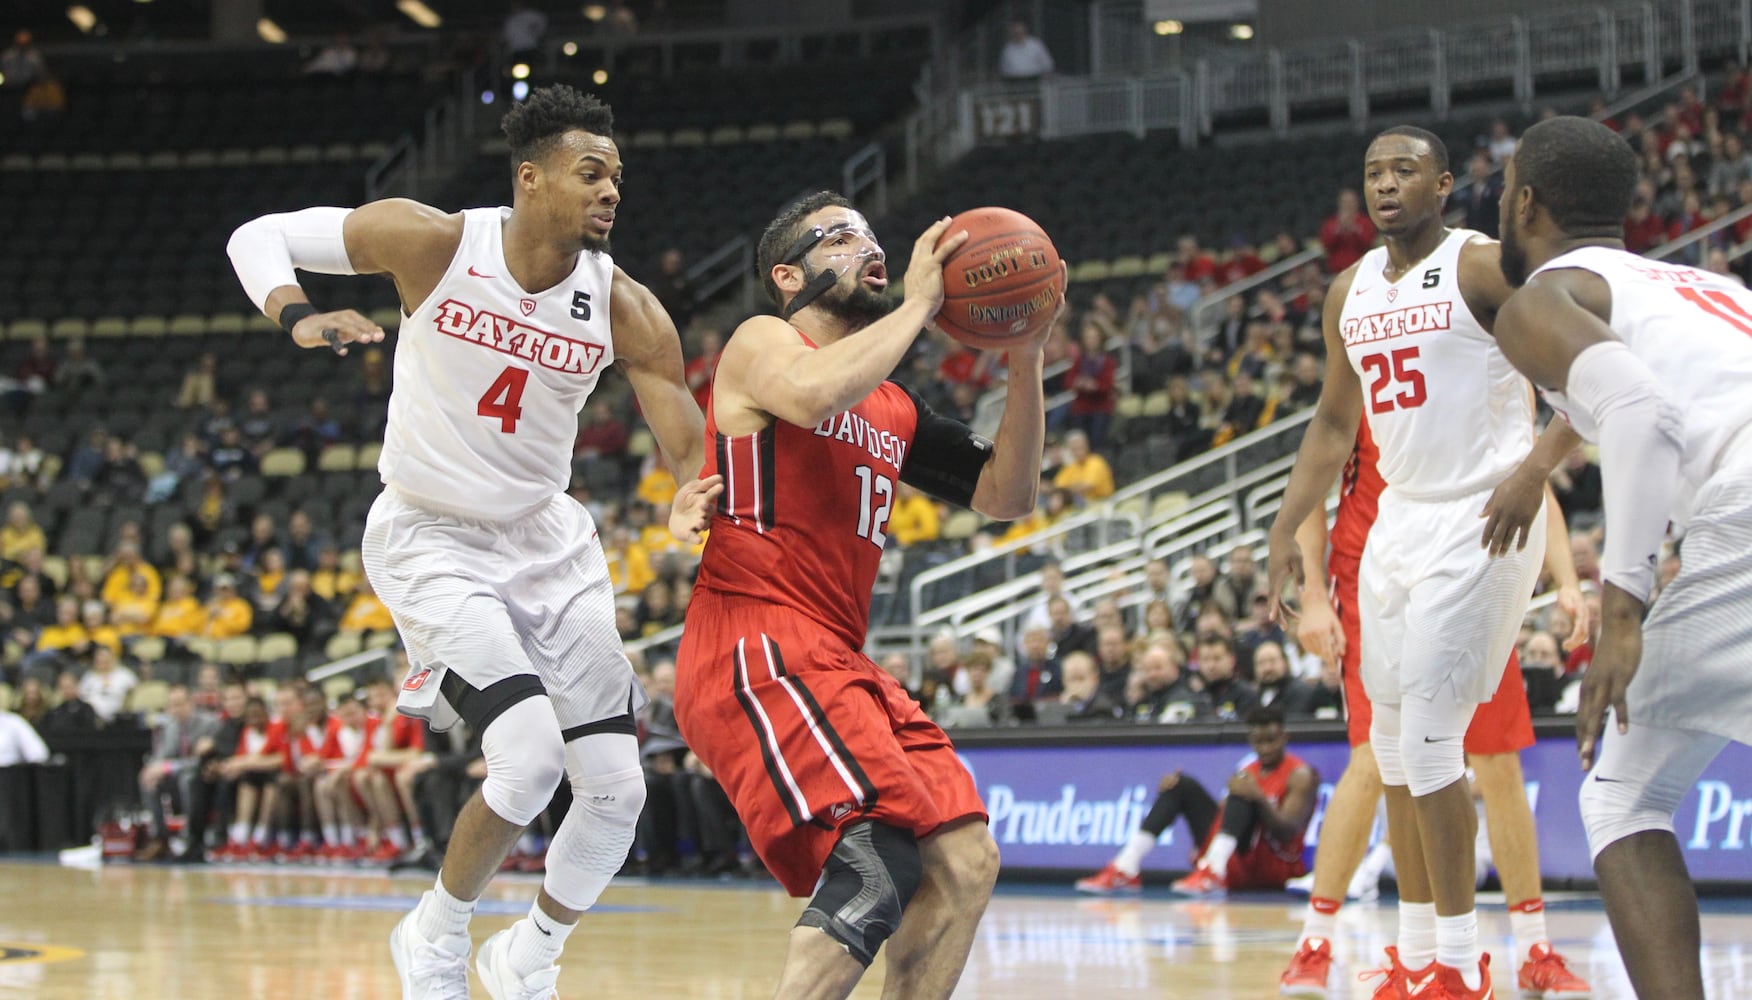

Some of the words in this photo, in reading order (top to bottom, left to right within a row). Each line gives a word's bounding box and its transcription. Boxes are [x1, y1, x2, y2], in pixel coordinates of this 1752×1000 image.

[570, 290, 591, 321] 5
[1422, 267, 1441, 289] 5
[433, 299, 605, 374] DAYTON
[1344, 301, 1452, 347] DAYTON
[477, 366, 529, 433] 4
[1361, 346, 1427, 414] 25
[814, 410, 906, 472] DAVIDSON
[855, 465, 893, 550] 12
[986, 784, 1174, 846] Prudenti
[1686, 781, 1752, 850] Pr
